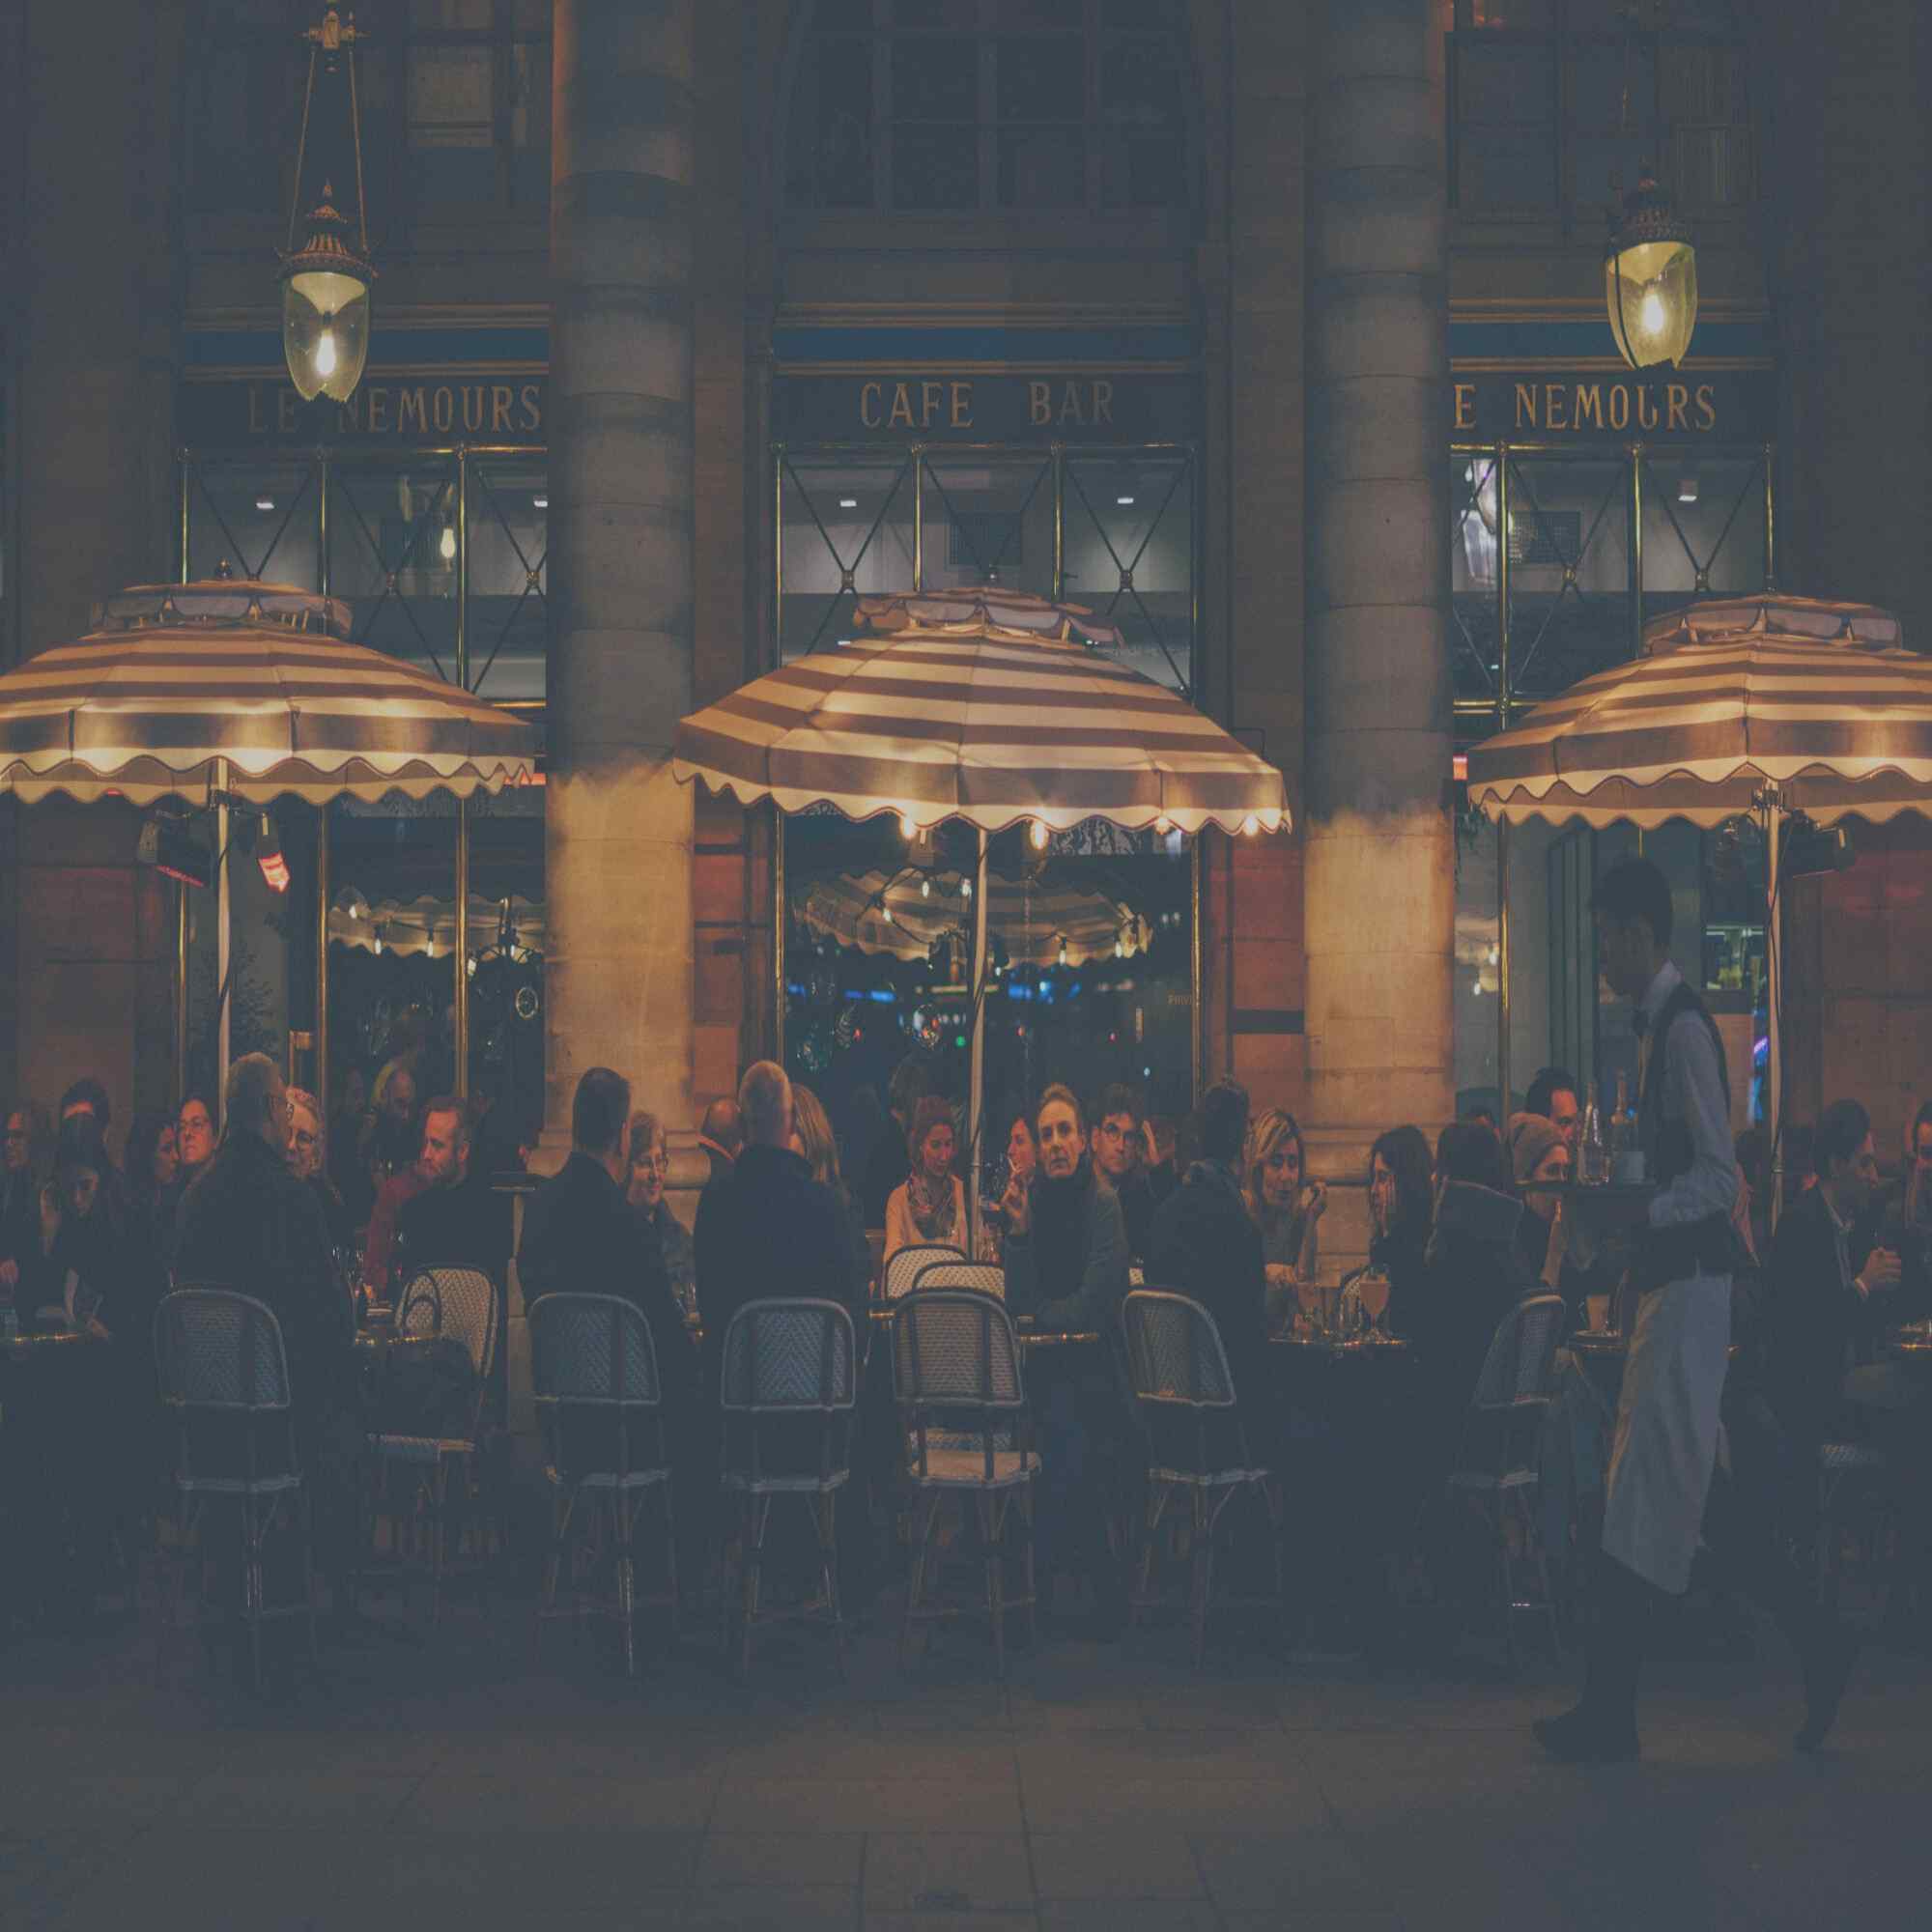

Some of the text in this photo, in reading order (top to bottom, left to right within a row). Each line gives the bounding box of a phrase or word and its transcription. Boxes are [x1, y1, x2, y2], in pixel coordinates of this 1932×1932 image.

[248, 385, 542, 433] LE NEMOURS
[860, 381, 1113, 428] CAFE BAR
[1515, 384, 1717, 431] NEMOURS
